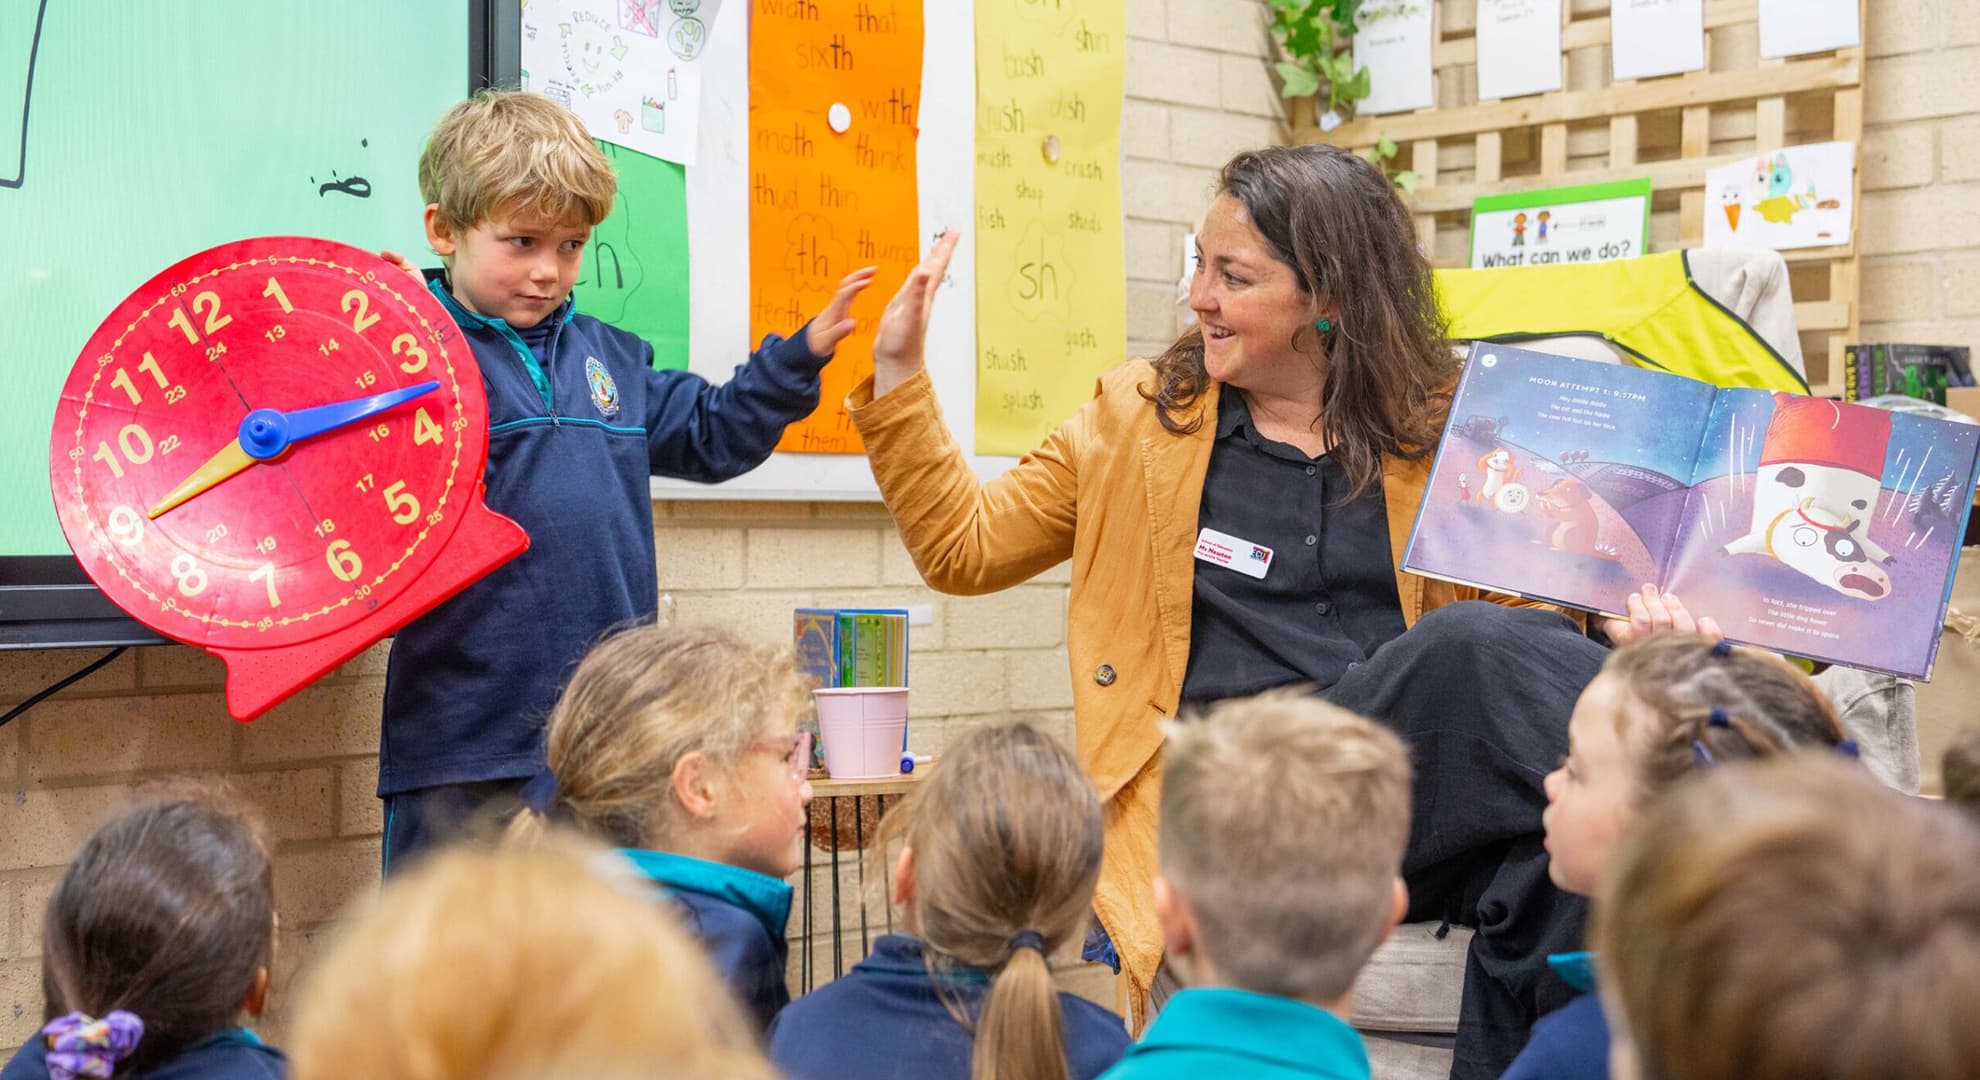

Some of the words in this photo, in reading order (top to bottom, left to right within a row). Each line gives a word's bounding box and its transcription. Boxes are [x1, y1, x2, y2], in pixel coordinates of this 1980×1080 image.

[760, 0, 819, 21] width
[856, 2, 897, 34] that
[797, 34, 853, 70] sixth
[862, 88, 912, 125] with
[1051, 90, 1085, 122] dish
[757, 123, 814, 157] moth
[856, 132, 906, 170] think
[753, 170, 800, 209] thud
[818, 172, 859, 211] thin
[268, 256, 277, 265] 5
[797, 233, 829, 277] th
[856, 228, 916, 270] thump
[1482, 253, 1523, 268] What
[1530, 252, 1560, 265] can
[1567, 247, 1592, 261] we
[1598, 240, 1631, 259] do?
[359, 271, 376, 285] 10
[1019, 238, 1059, 300] sh
[171, 283, 187, 297] 60
[262, 276, 294, 314] 1
[168, 290, 233, 345] 12
[341, 289, 381, 334] 2
[753, 288, 806, 330] tenth
[265, 324, 286, 344] 13
[427, 330, 444, 345] 15
[205, 342, 227, 362] 24
[318, 338, 340, 357] 14
[391, 333, 428, 374] 3
[98, 353, 114, 367] 55
[110, 351, 170, 406] 11
[355, 370, 376, 390] 15
[1528, 376, 1558, 387] MOON
[1559, 381, 1601, 393] ATTEMPT
[164, 385, 187, 405] 23
[369, 424, 391, 443] 16
[413, 406, 444, 447] 4
[452, 417, 468, 433] 20
[158, 434, 181, 455] 22
[801, 427, 848, 450] them
[69, 446, 85, 461] 50
[93, 423, 154, 479] 10
[355, 473, 375, 493] 17
[383, 480, 421, 525] 5
[108, 505, 144, 547] 9
[314, 518, 336, 538] 18
[426, 511, 443, 526] 25
[205, 524, 227, 544] 20
[256, 536, 277, 555] 19
[326, 539, 363, 582] 6
[1208, 547, 1232, 560] Newton
[170, 553, 208, 597] 8
[248, 562, 281, 608] 7
[354, 584, 372, 601] 30
[160, 598, 177, 613] 40
[256, 616, 273, 632] 35
